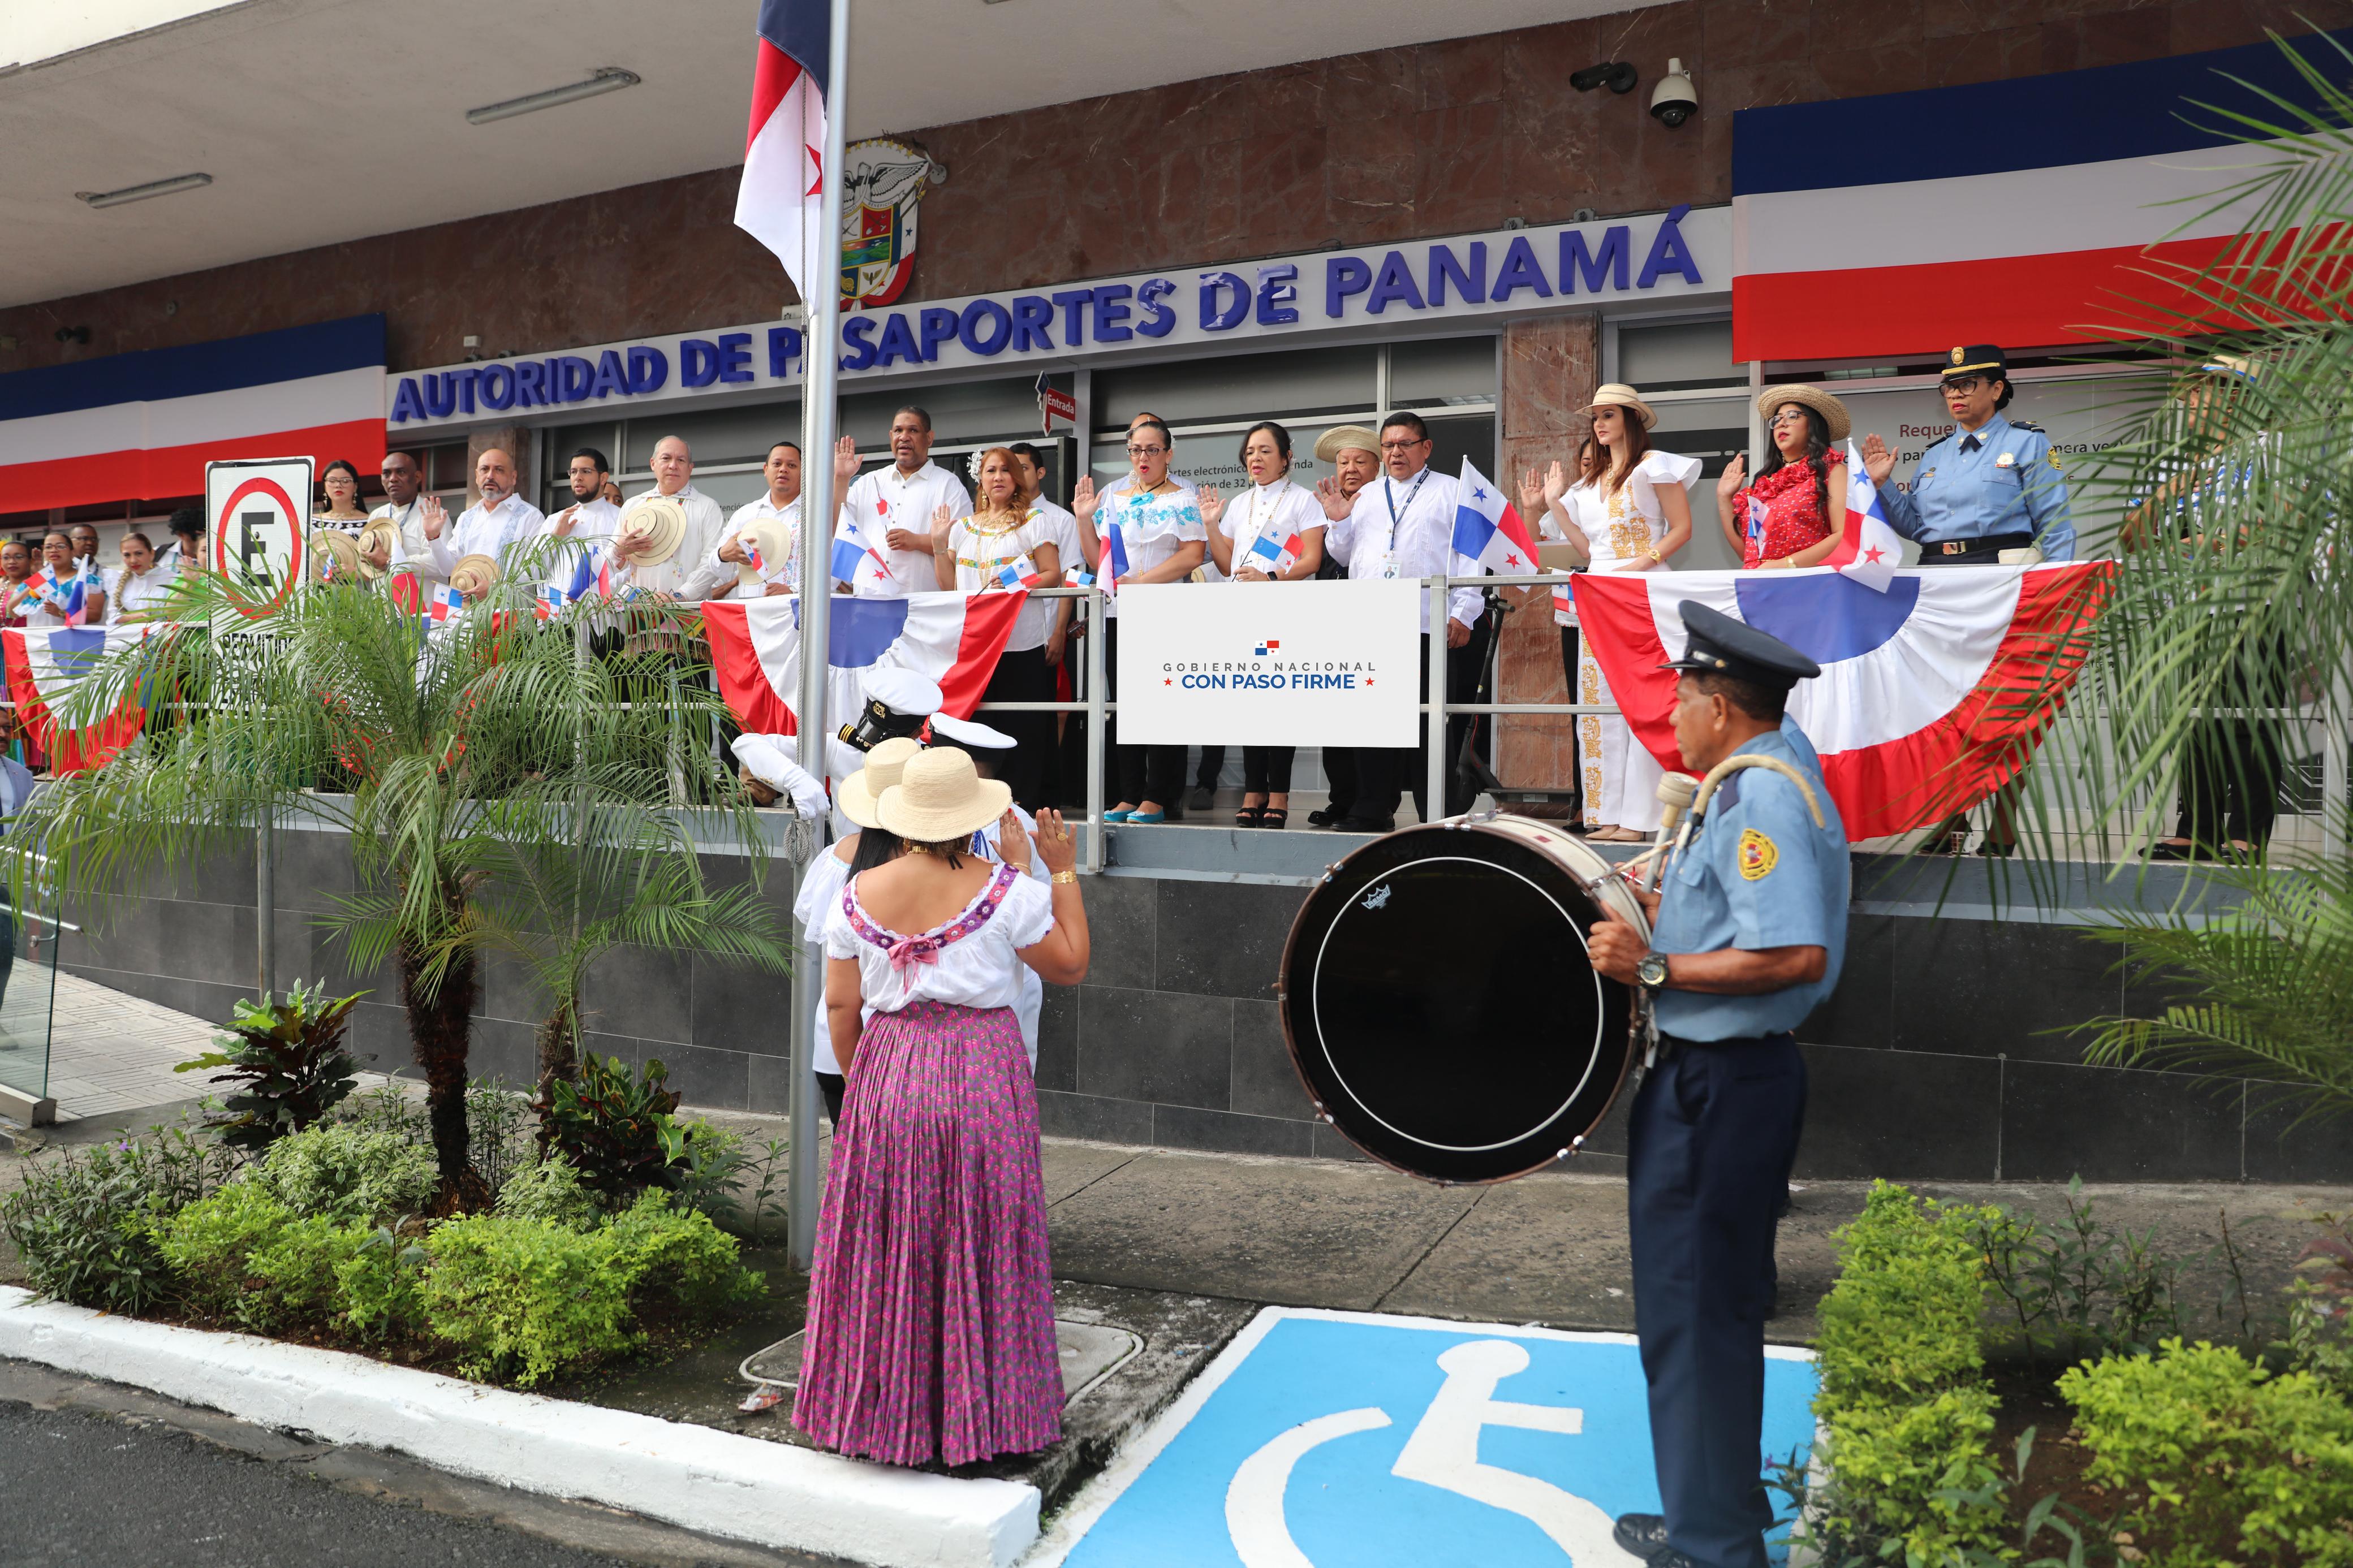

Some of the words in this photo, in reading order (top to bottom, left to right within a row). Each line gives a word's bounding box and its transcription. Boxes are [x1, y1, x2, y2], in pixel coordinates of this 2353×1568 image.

[390, 346, 669, 422] AUTORIDAD
[680, 333, 754, 388] DE
[769, 278, 1177, 378] PSAPORTES
[1199, 264, 1299, 332] DE
[1326, 204, 1703, 318] PANAMÁ
[1048, 394, 1074, 414] Entrada
[1219, 479, 1231, 489] de
[1234, 478, 1246, 487] 32
[242, 512, 274, 586] E
[1163, 663, 1261, 672] GOBIERNO
[1274, 662, 1376, 671] NACIONAL
[1182, 675, 1226, 689] CON
[1232, 675, 1286, 689] PASO
[1292, 675, 1355, 689] FIRME
[1368, 891, 1387, 906] REMO
